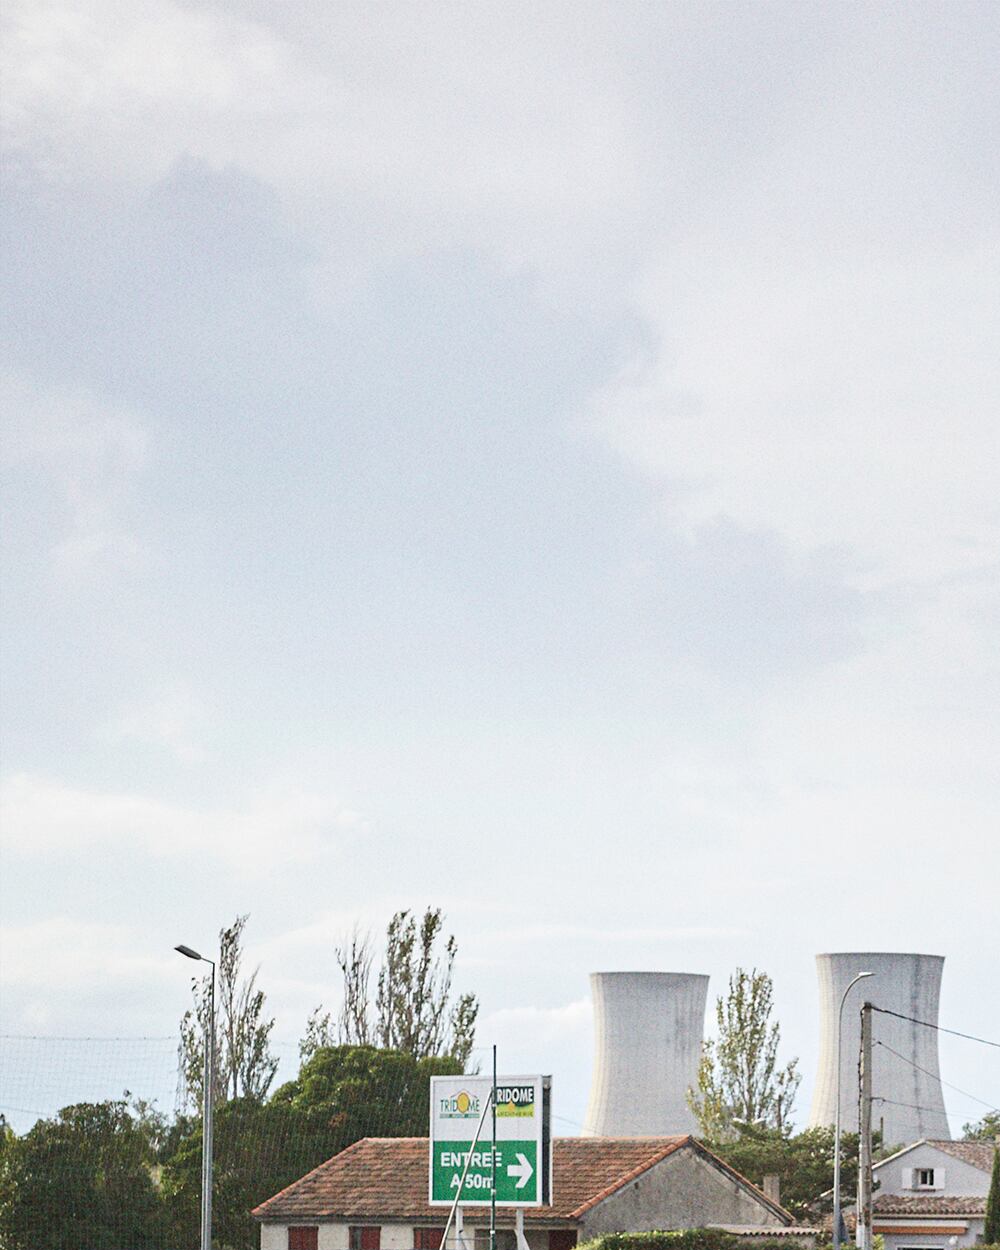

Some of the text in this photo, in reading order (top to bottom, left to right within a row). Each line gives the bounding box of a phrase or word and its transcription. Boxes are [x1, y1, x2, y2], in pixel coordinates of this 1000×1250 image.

[493, 1087, 533, 1102] RIDOME
[441, 1152, 502, 1167] ENTREE
[450, 1173, 461, 1189] A
